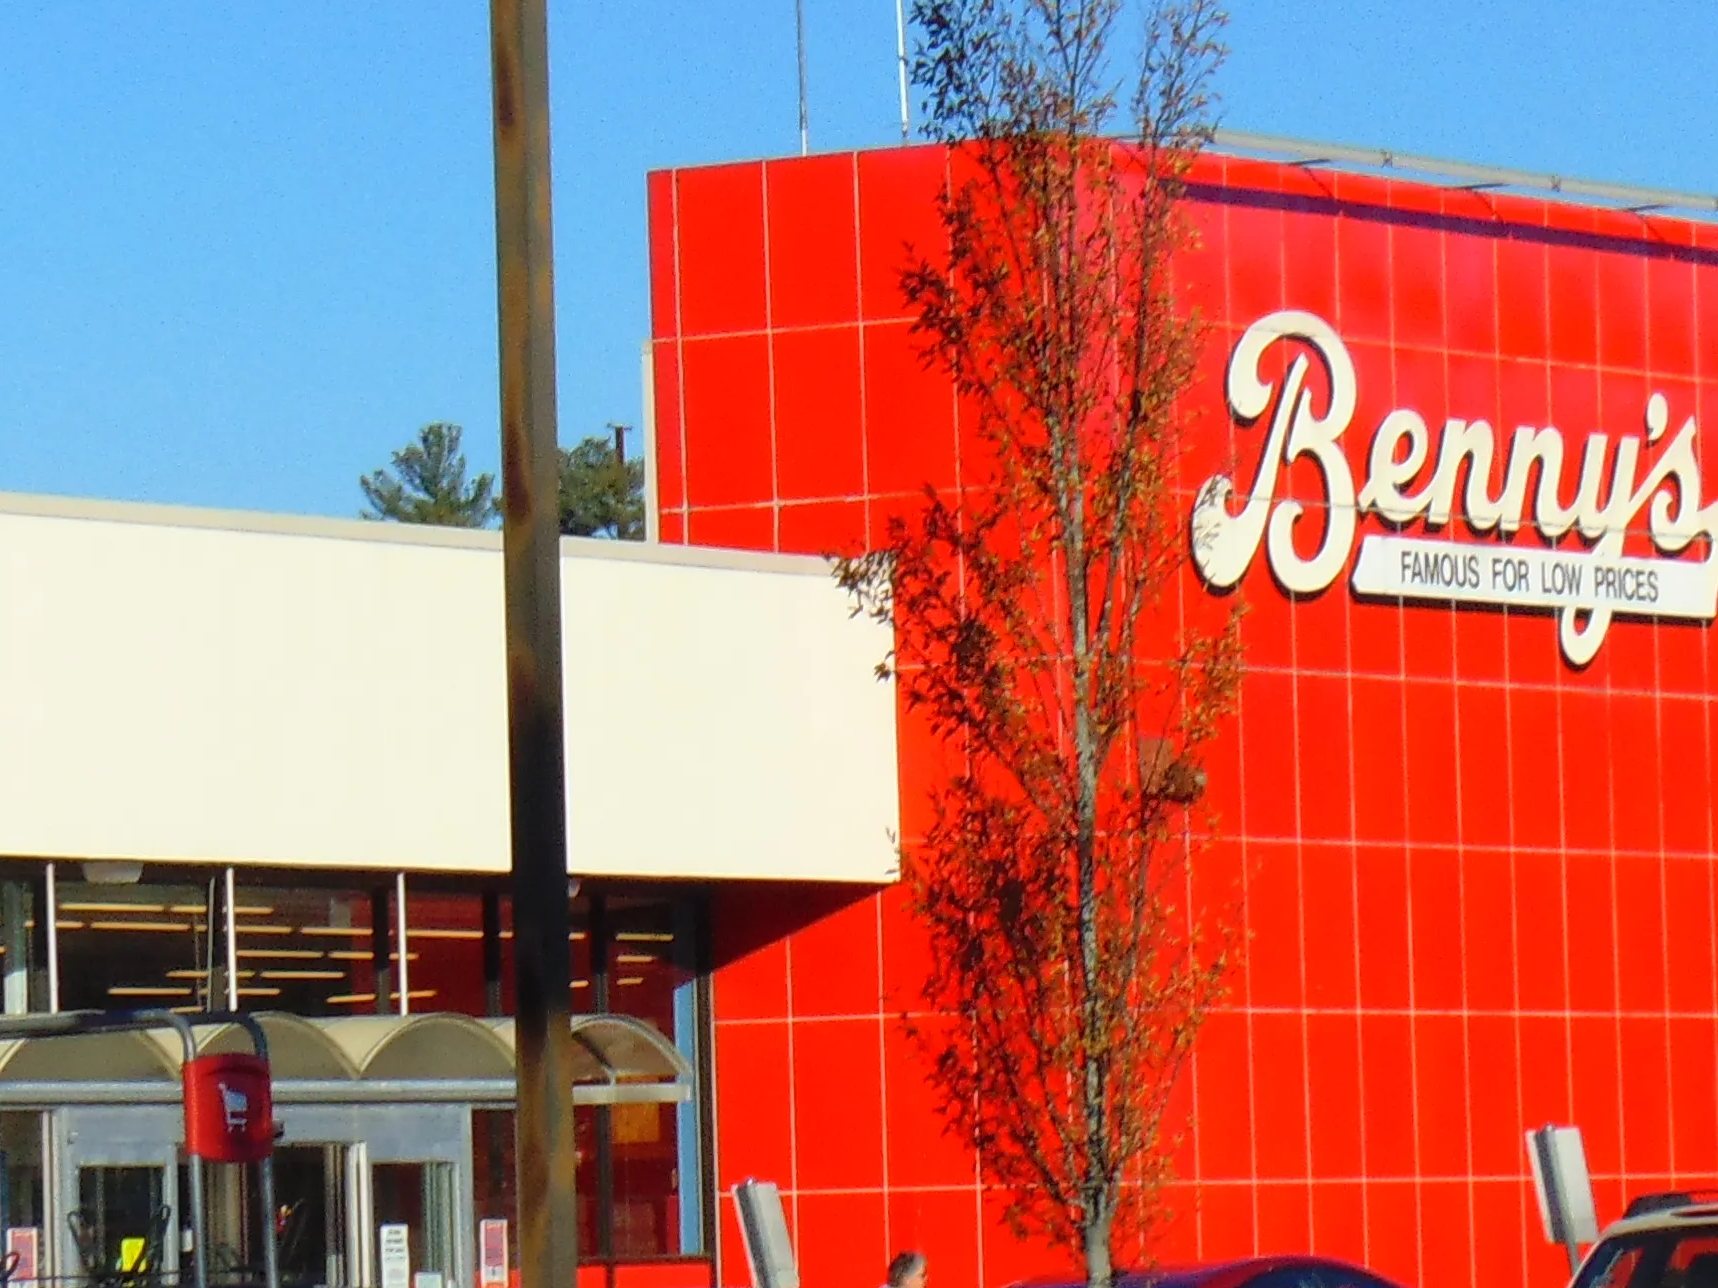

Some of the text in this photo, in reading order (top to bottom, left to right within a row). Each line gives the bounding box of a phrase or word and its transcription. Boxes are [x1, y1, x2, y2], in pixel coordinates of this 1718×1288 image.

[1400, 550, 1659, 604] FAMOUS FOR LOW PRICES
